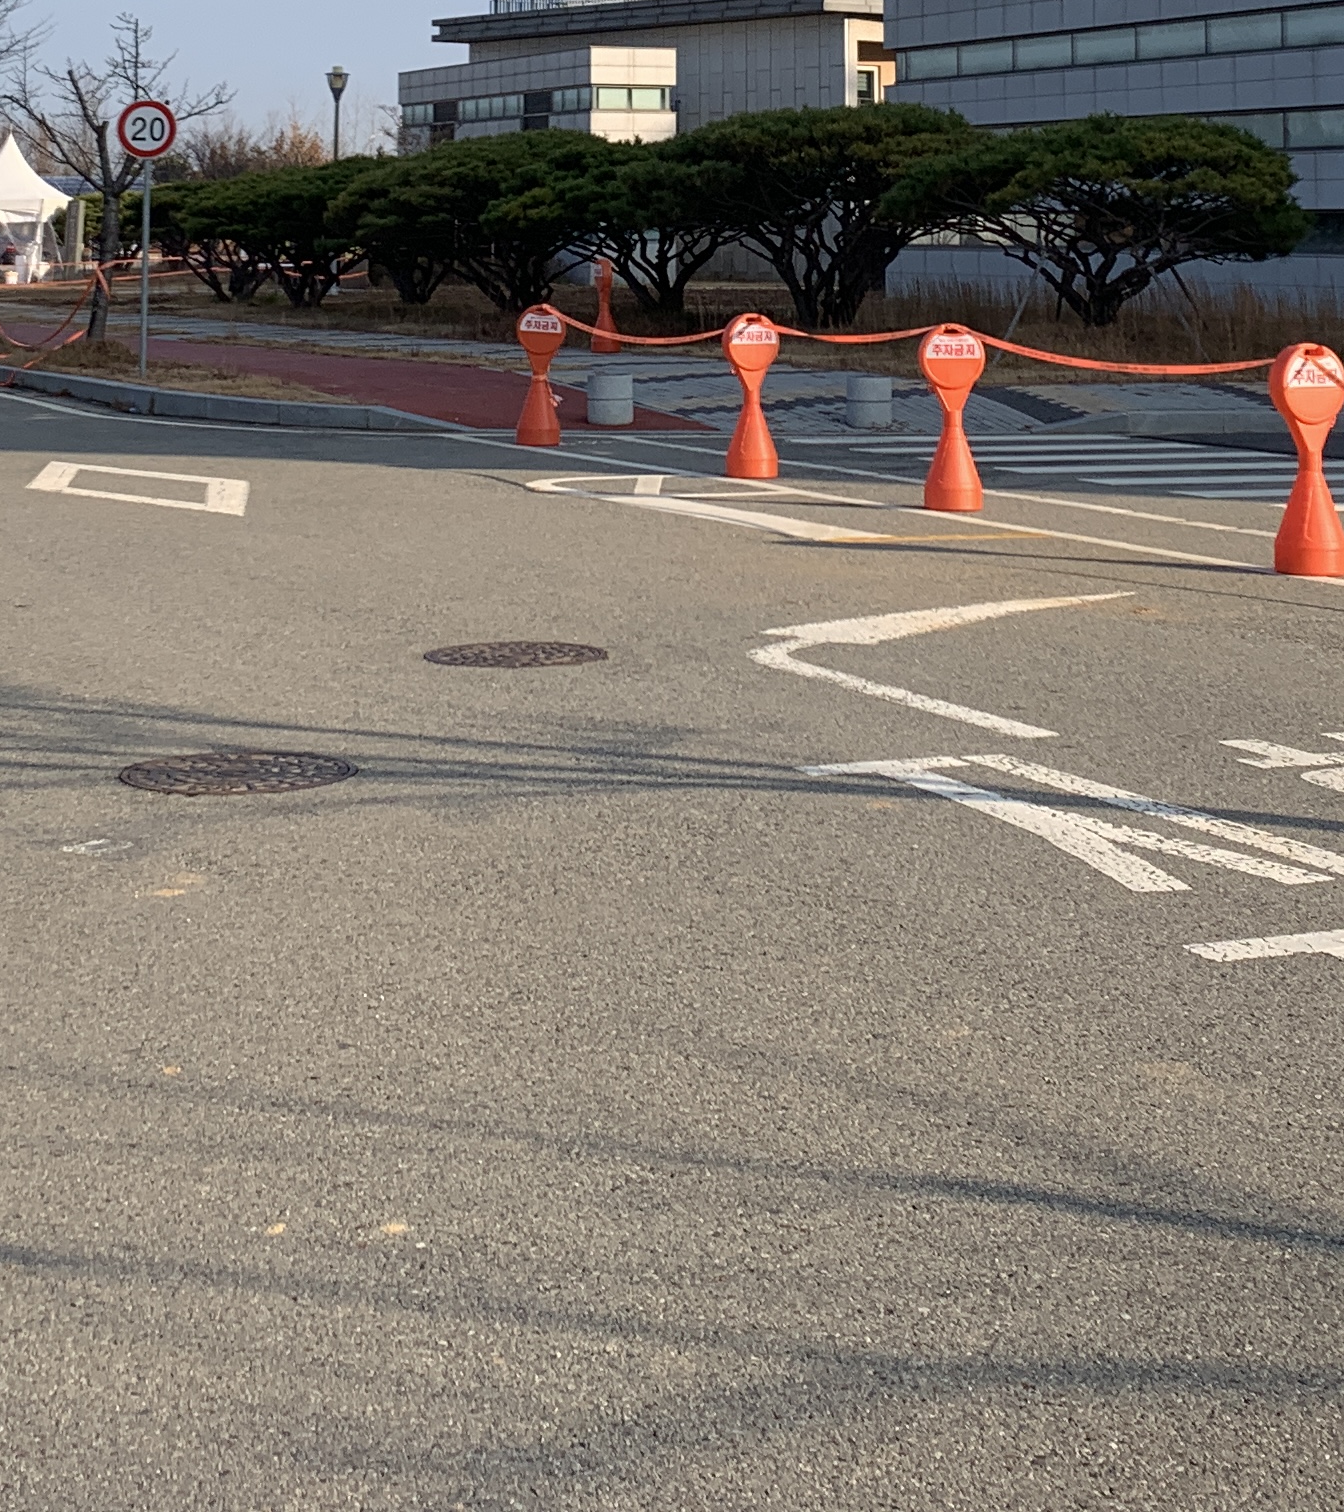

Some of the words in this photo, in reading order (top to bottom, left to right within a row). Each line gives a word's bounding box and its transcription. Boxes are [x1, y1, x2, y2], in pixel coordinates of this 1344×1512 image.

[131, 116, 165, 141] 20
[525, 319, 558, 331] 주차금지
[931, 343, 975, 356] 주차금지
